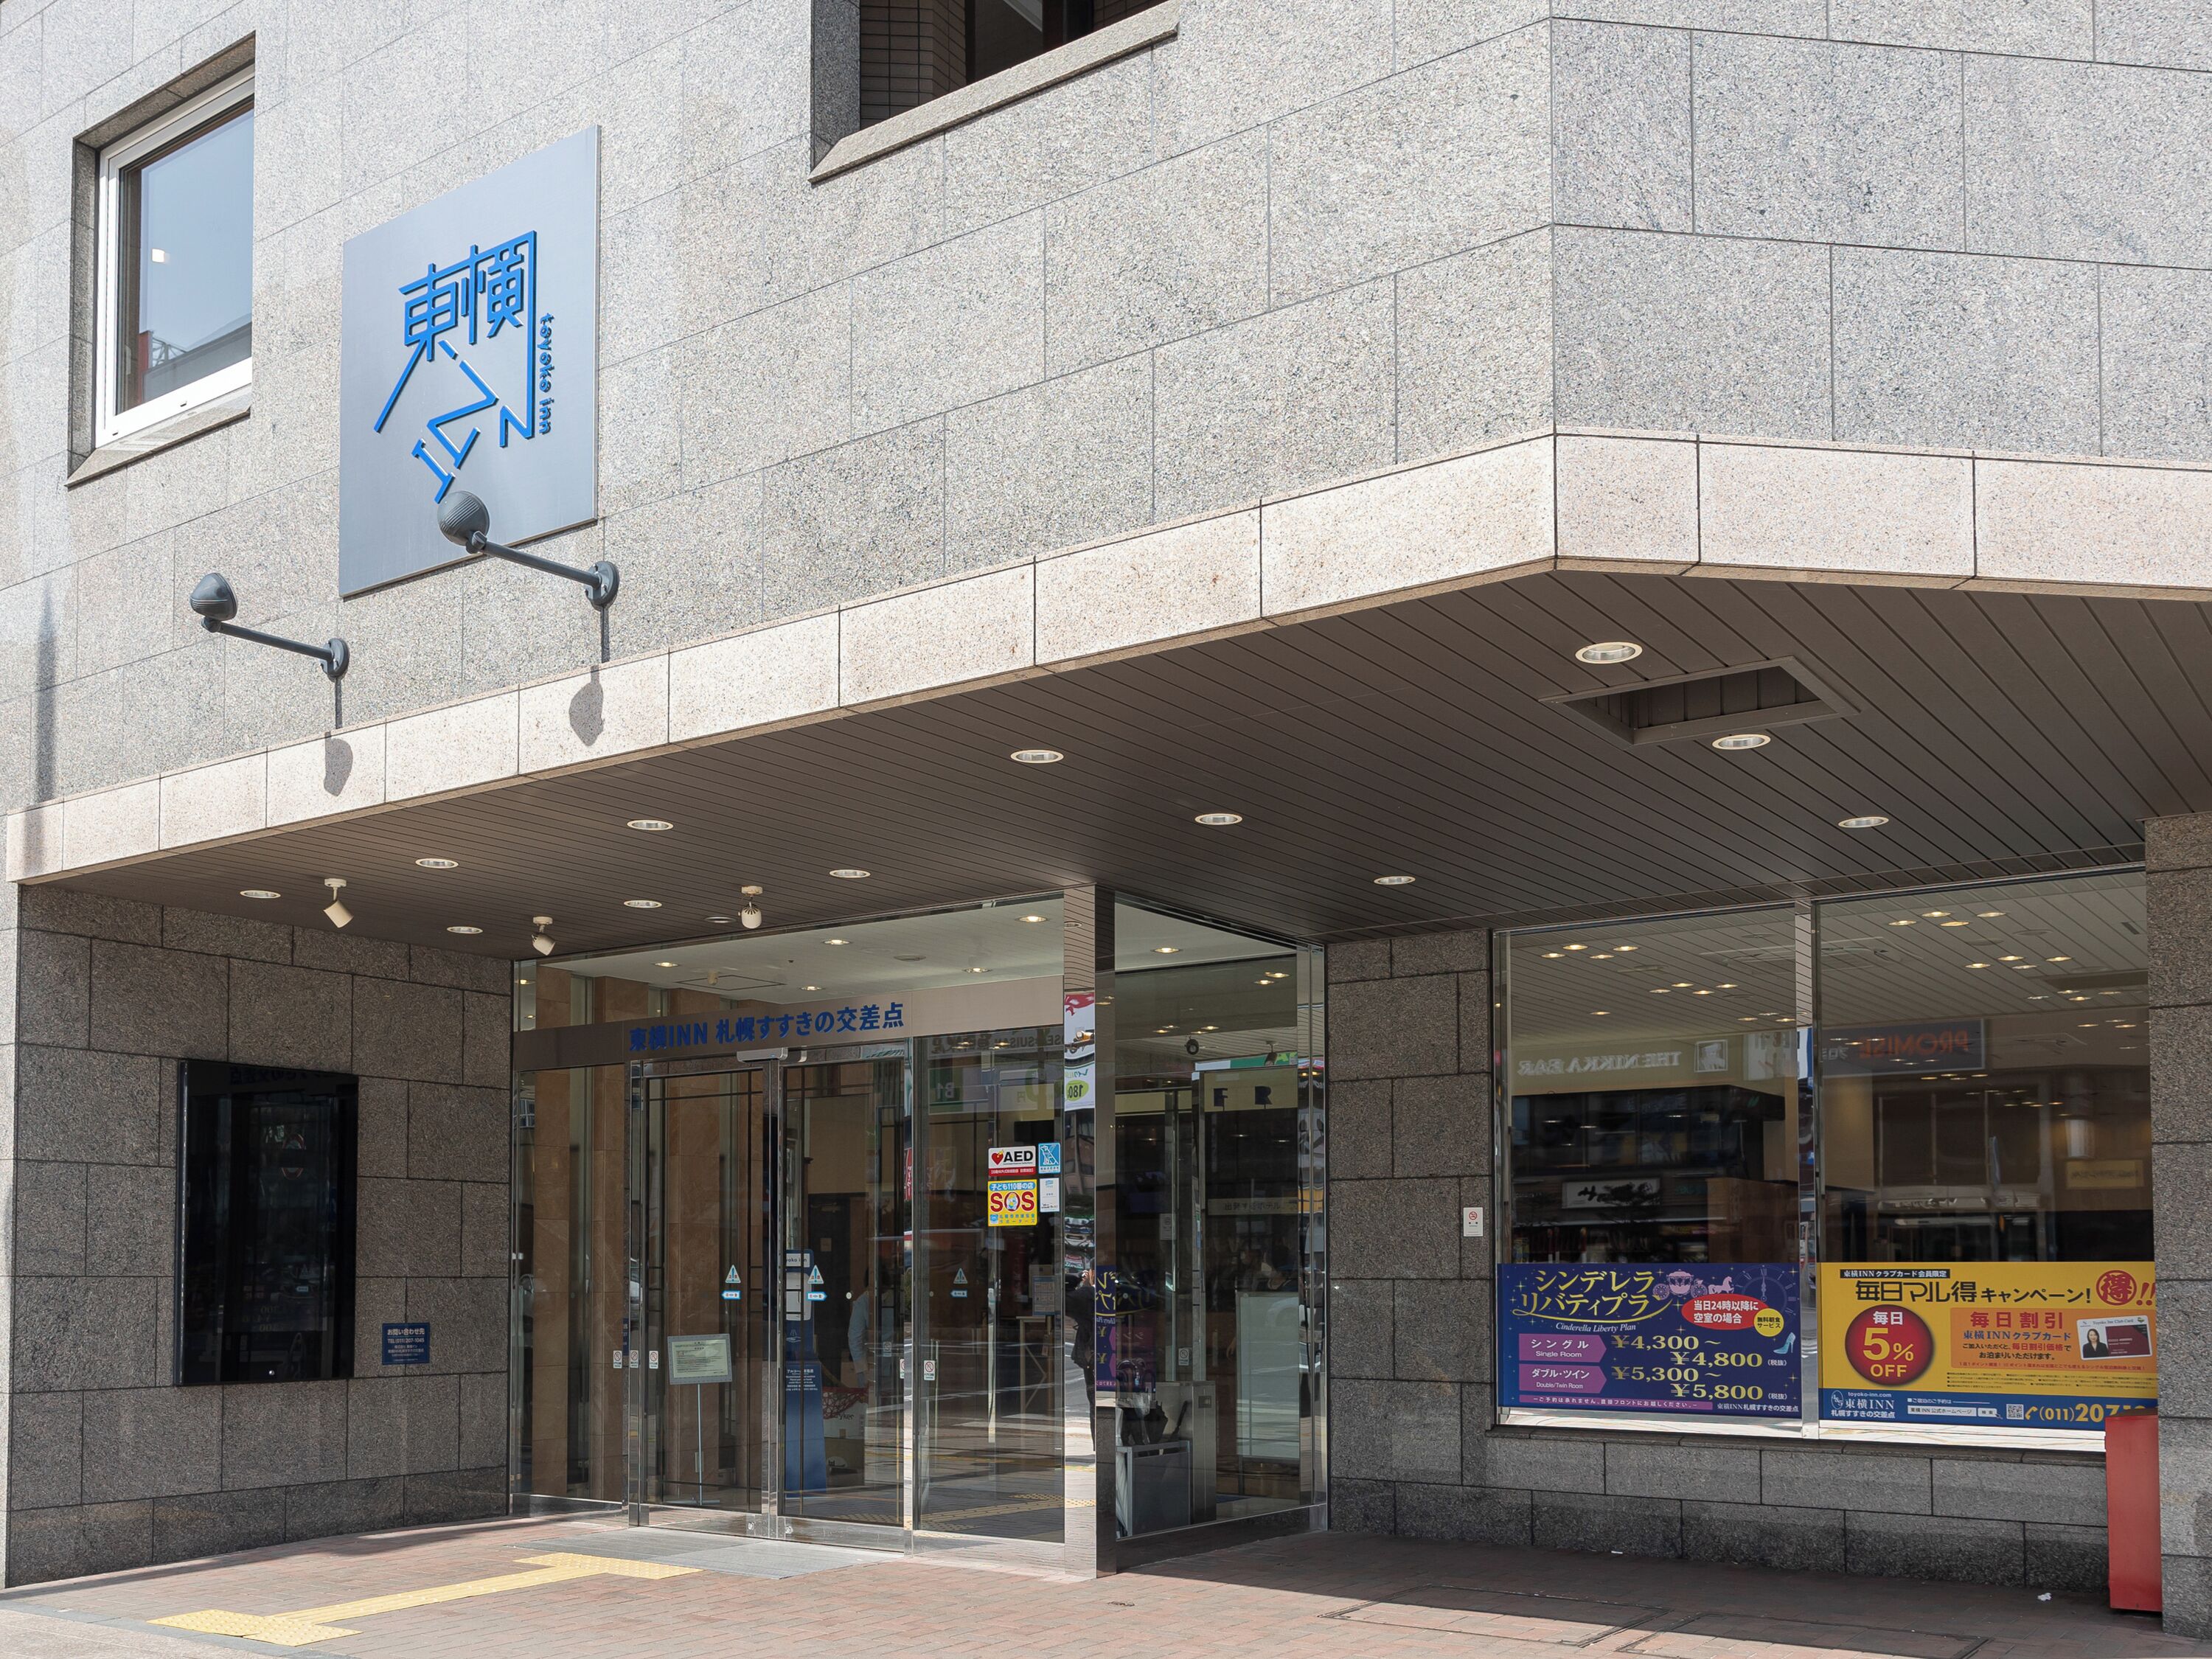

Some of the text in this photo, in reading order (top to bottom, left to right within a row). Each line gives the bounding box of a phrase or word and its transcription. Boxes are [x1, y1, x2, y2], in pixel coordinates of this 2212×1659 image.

[538, 313, 554, 435] toyoko inn
[630, 1021, 708, 1051] 東横INN
[715, 1001, 905, 1045] 札幌すすきの交差点
[1004, 1150, 1034, 1163] AED
[990, 1191, 1035, 1212] SOS
[1843, 1270, 1947, 1279] 東横INNクラブカード会員限定
[1534, 1270, 1655, 1293] シンデレラ
[1514, 1292, 1672, 1321] リバティプラン
[1693, 1300, 1759, 1311] 当日24時以降に
[1693, 1312, 1742, 1324] 空室の場合
[1873, 1310, 1903, 1325] 毎日
[1970, 1311, 2063, 1329] 毎日割引
[1556, 1322, 1591, 1331] Cinderella
[1593, 1324, 1618, 1334] Liberty
[1963, 1329, 2071, 1341] 東横INNクラブカード
[1531, 1339, 1590, 1349] シングル
[1863, 1326, 1914, 1362] 5%
[1670, 1351, 1763, 1368] ¥4,800
[1979, 1352, 2055, 1360] お泊まりいただけます。
[1531, 1368, 1590, 1379] ダブル・ツイン
[1870, 1363, 1907, 1377] OFF
[1670, 1382, 1763, 1400] ¥5,800
[1845, 1399, 1894, 1410] 東横INN
[1830, 1409, 1896, 1419] 札幌すすきの交差点
